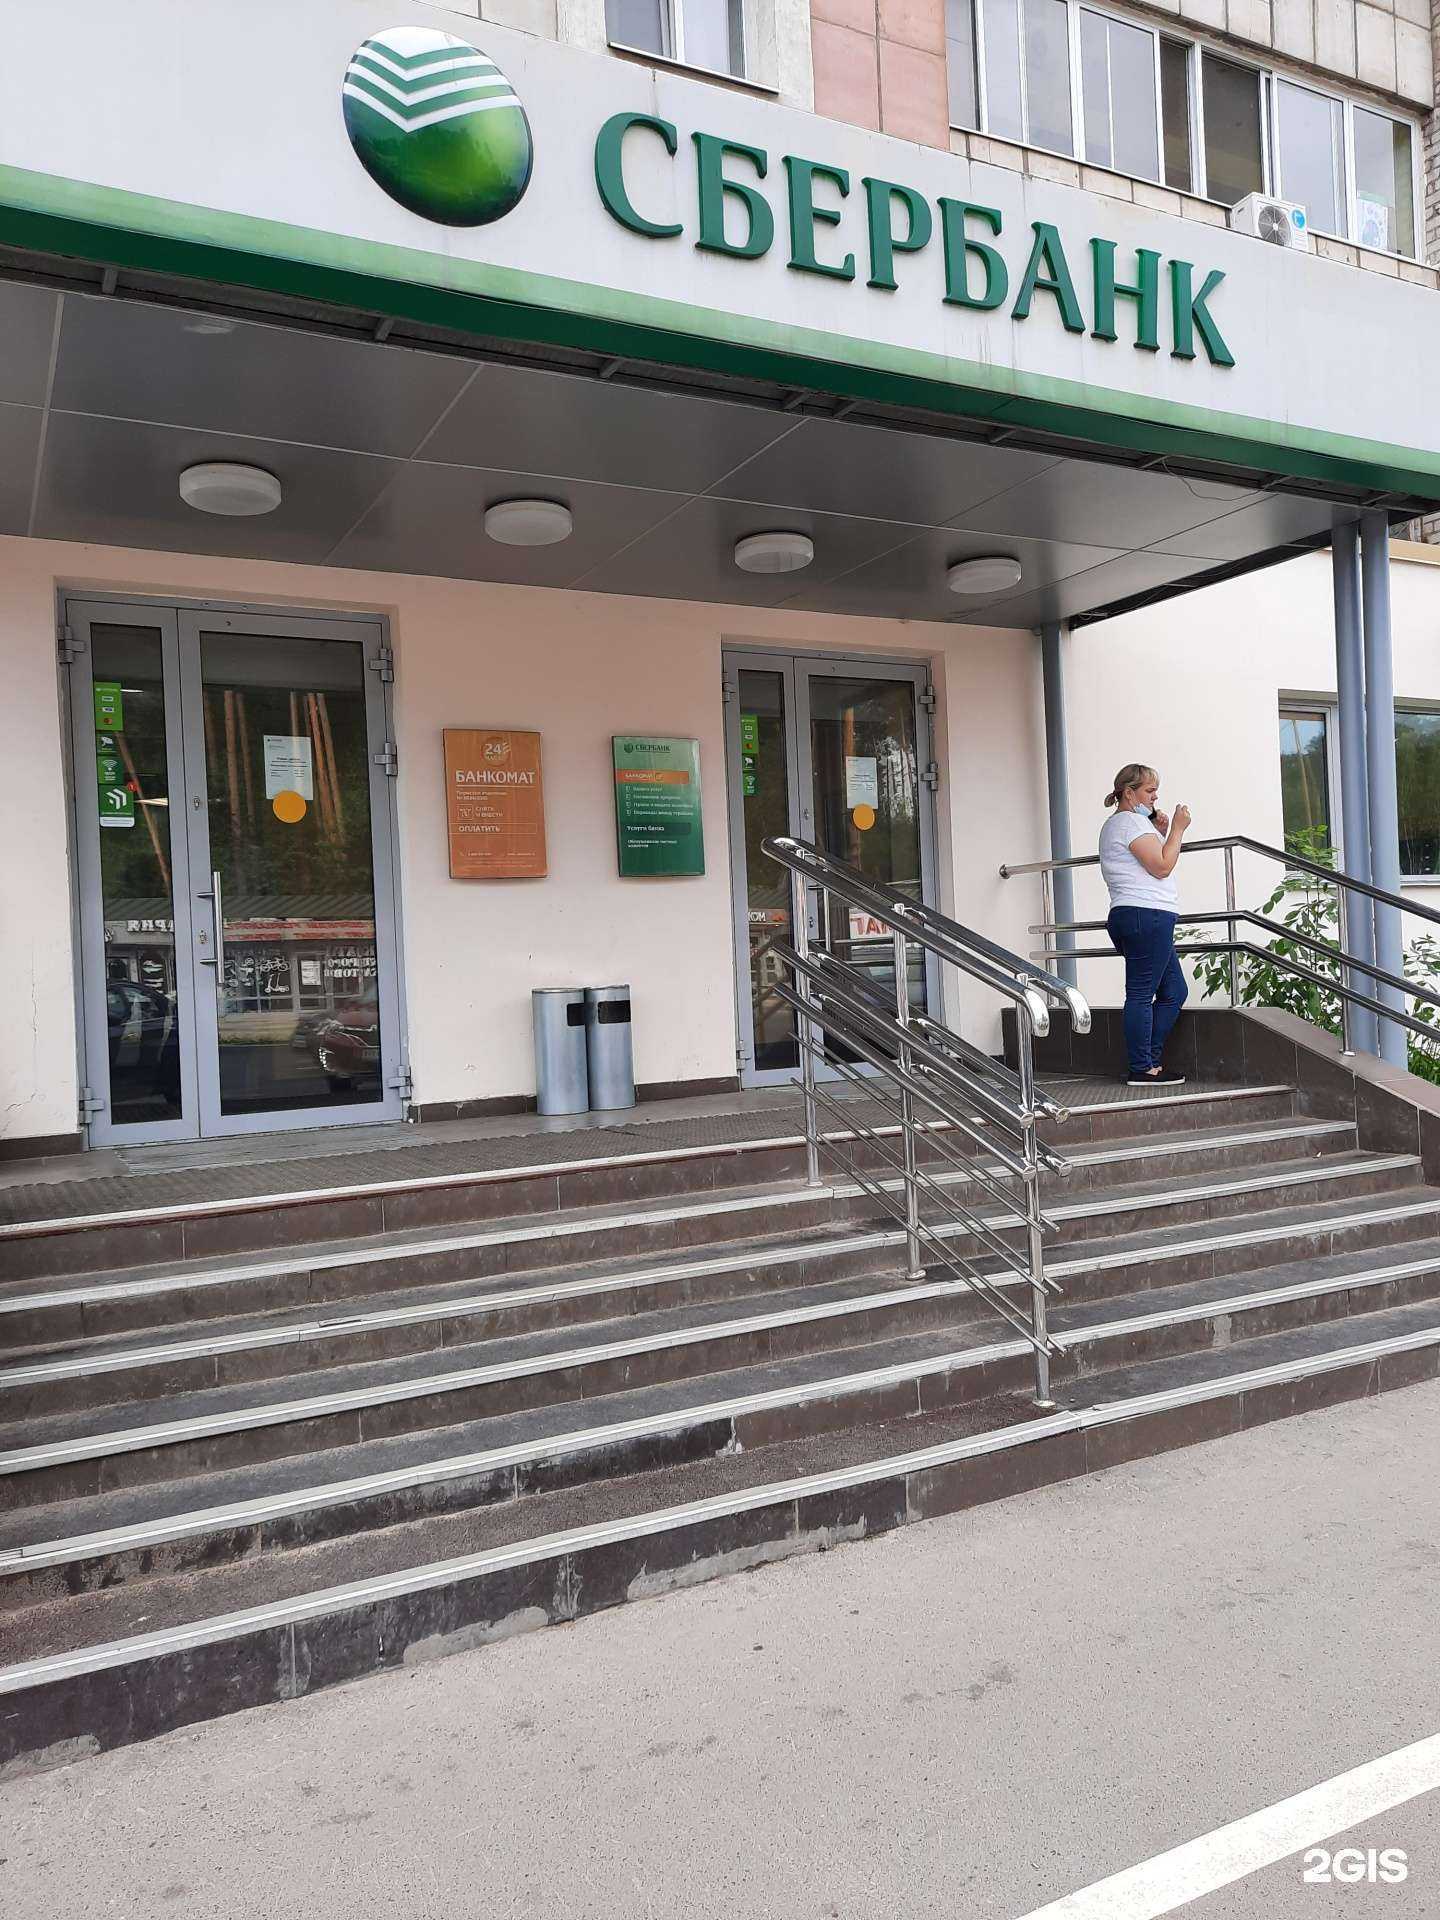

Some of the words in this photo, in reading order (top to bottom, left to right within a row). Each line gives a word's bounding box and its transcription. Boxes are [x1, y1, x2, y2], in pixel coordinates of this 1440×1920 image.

[594, 111, 1235, 367] СБЕРБАНК
[455, 770, 536, 784] БАНКОМАТ
[458, 825, 501, 833] ОПЛАТИТЬ
